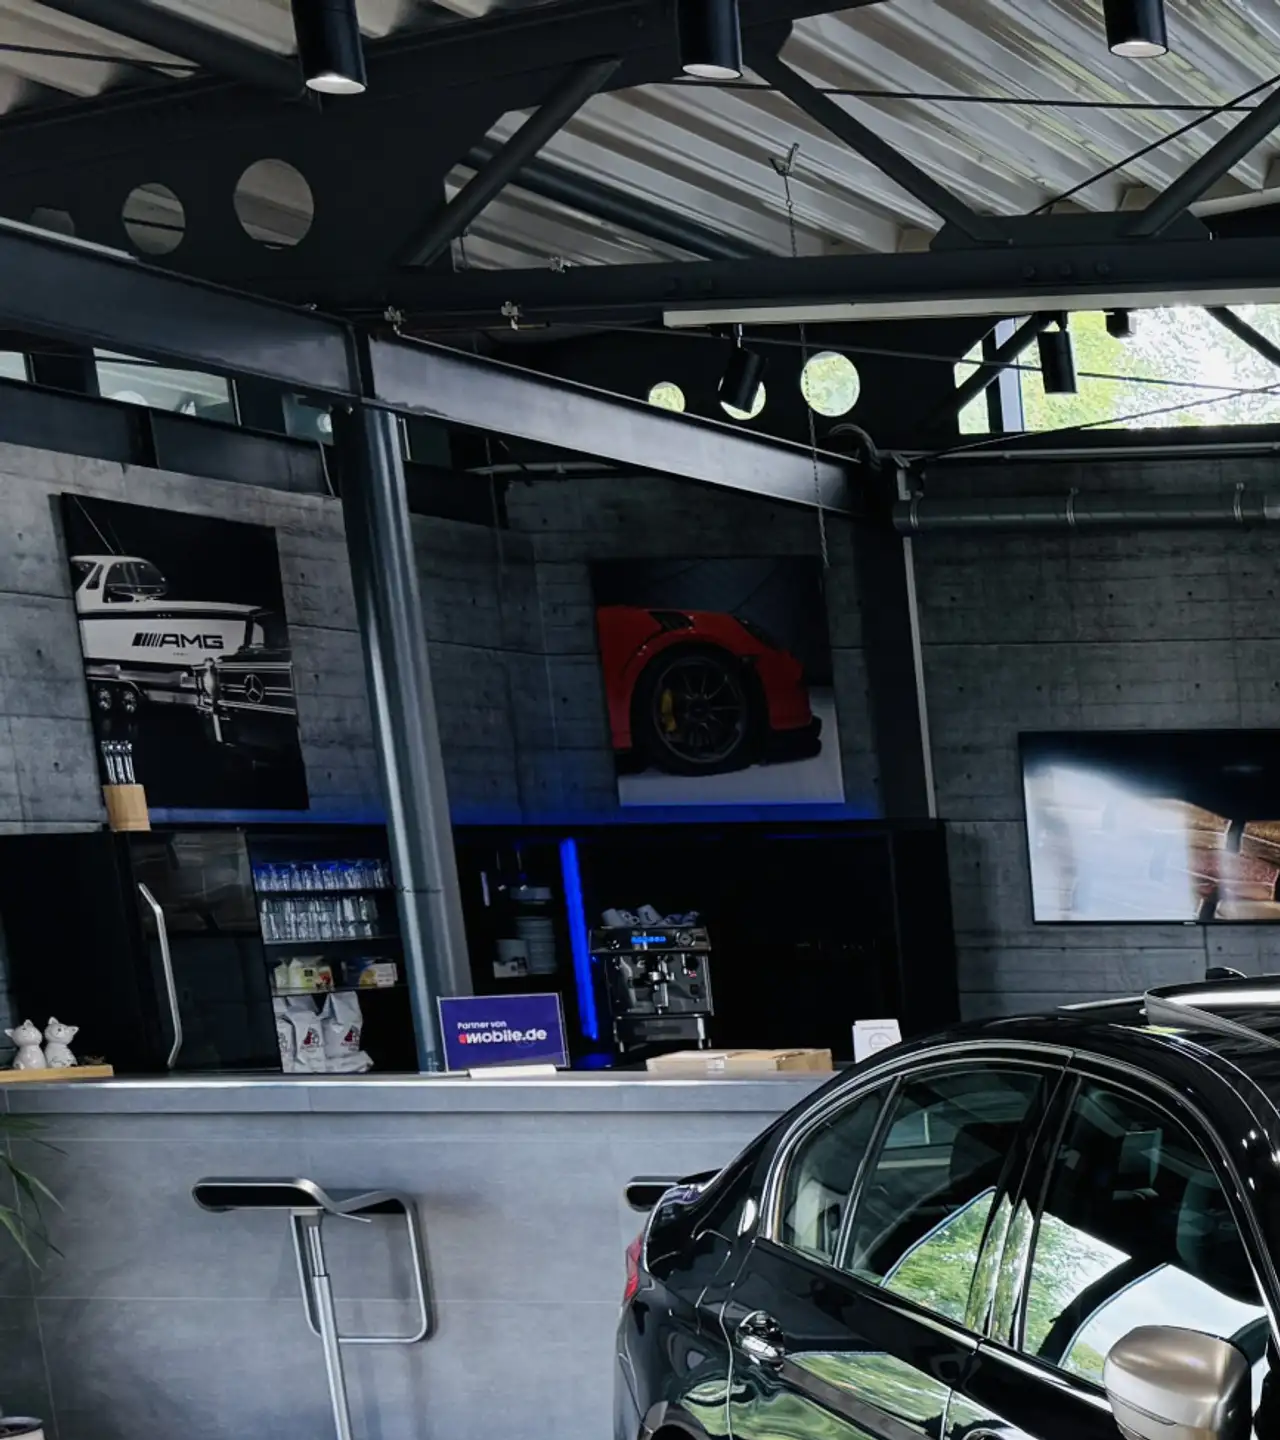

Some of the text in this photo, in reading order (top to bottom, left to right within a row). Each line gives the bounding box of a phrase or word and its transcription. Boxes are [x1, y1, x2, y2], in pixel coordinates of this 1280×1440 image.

[159, 633, 224, 650] AMG
[457, 1020, 507, 1030] Partner von
